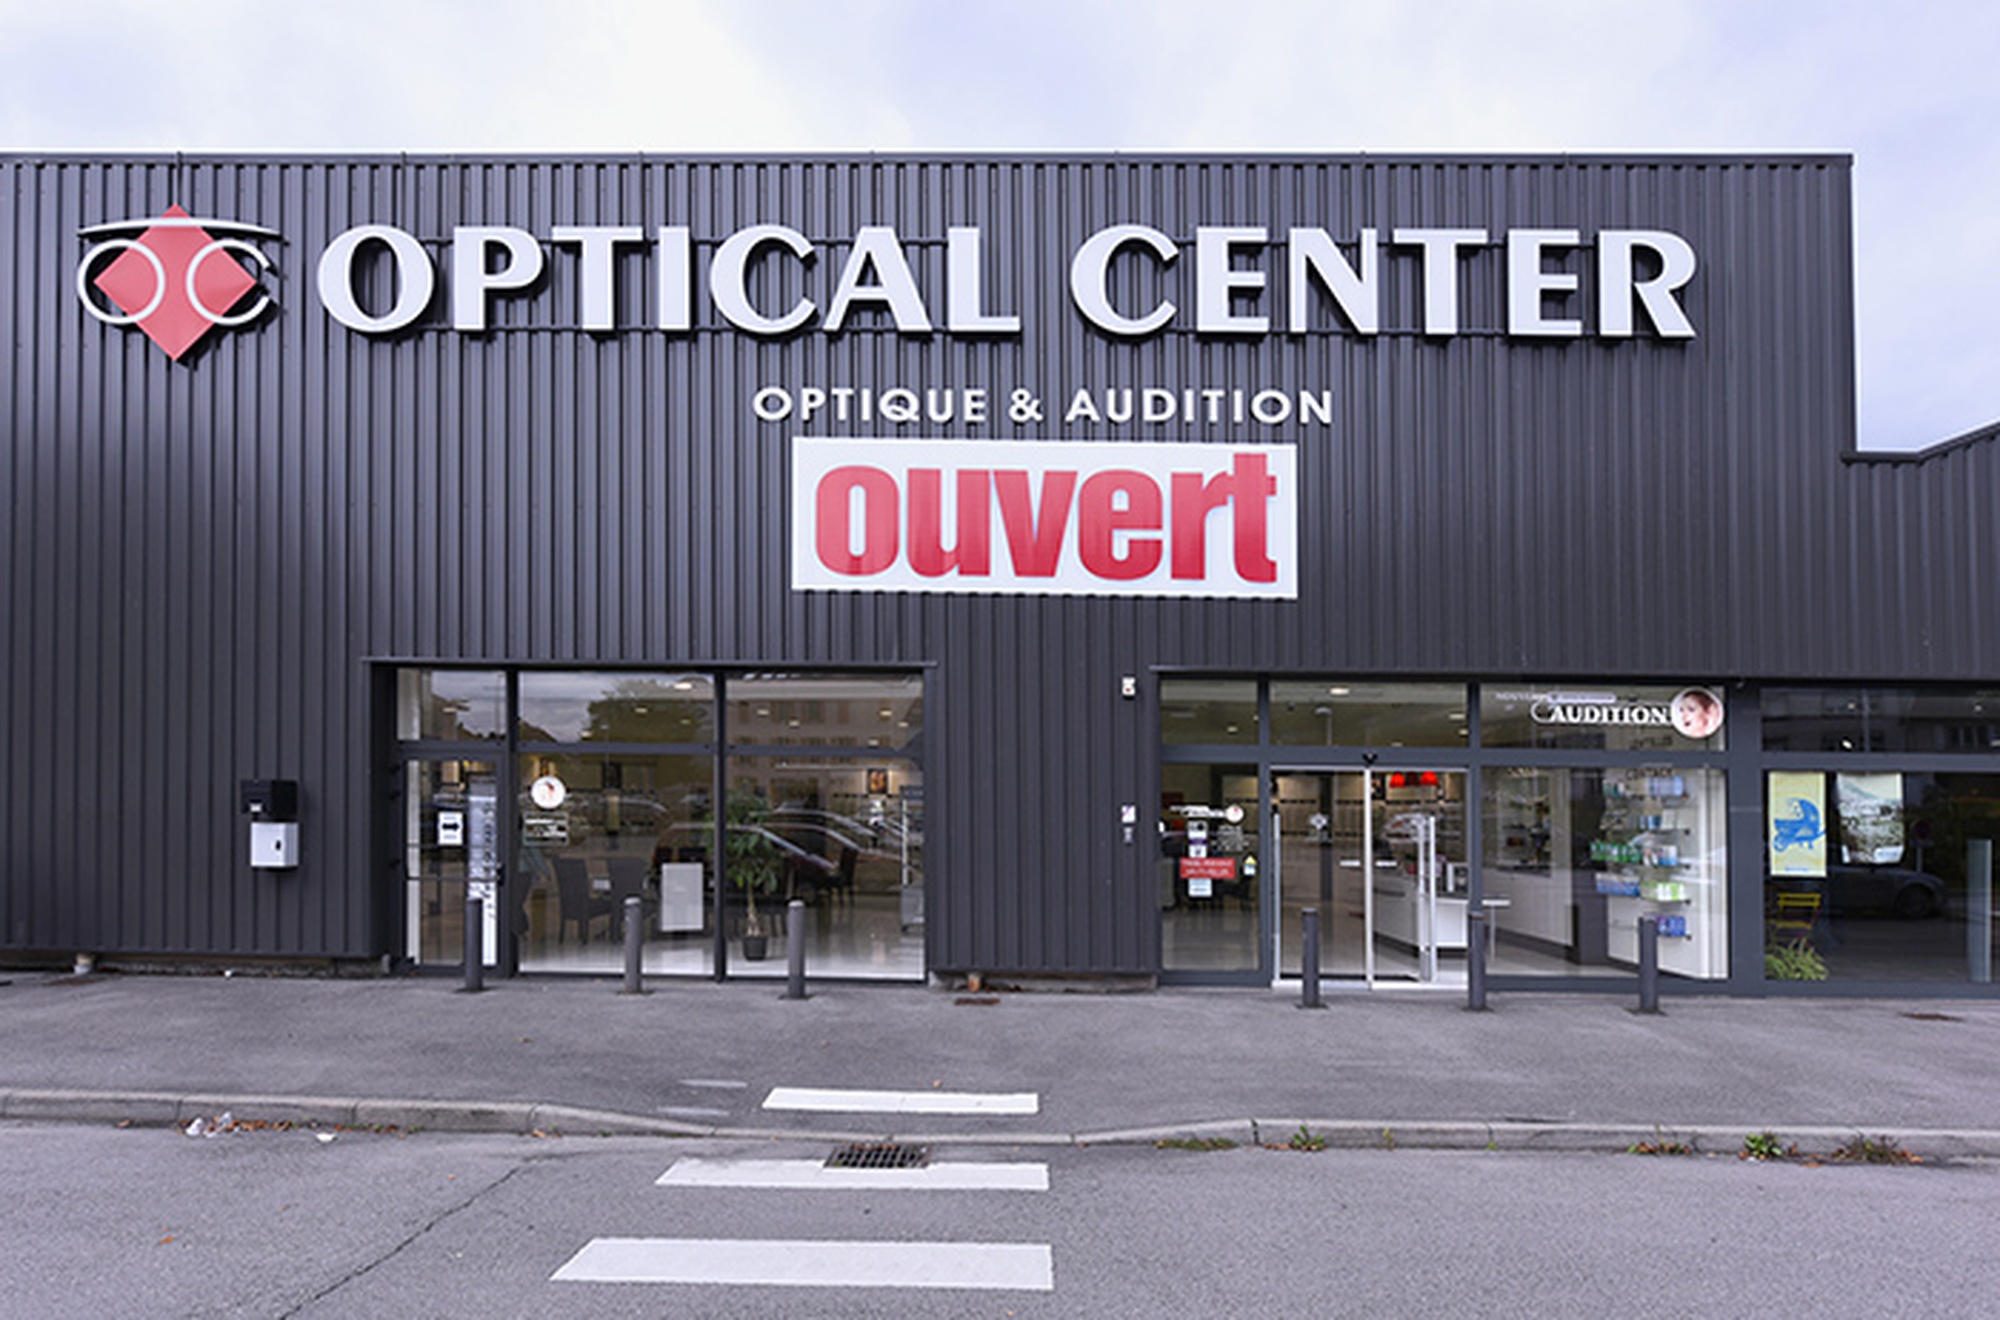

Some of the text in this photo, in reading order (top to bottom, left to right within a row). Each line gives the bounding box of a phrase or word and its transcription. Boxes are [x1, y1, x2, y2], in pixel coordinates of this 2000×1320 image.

[316, 222, 1021, 333] OPTICAL
[1070, 223, 1697, 338] CENTER
[751, 385, 1333, 425] OPTIQUE & AUDITION
[815, 452, 1278, 584] ouvert
[1549, 705, 1669, 724] AUDITION
